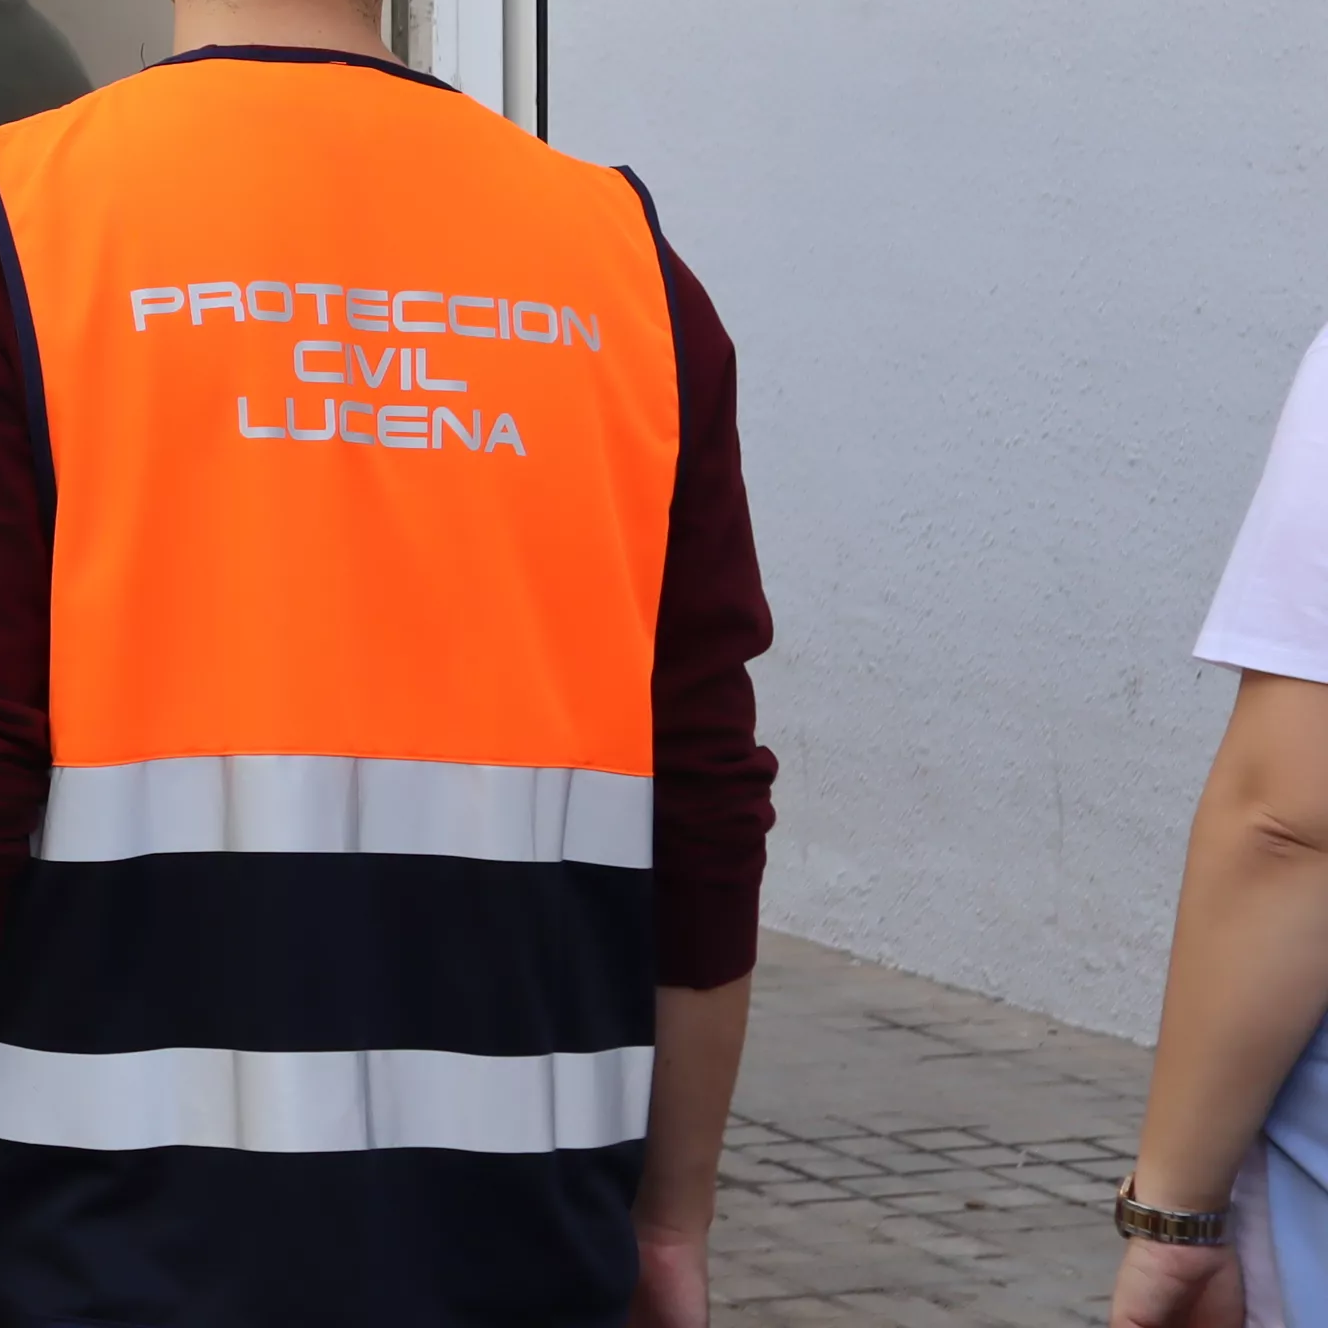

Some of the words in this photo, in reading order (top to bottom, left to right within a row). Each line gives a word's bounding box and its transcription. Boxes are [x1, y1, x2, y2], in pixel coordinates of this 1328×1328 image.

[130, 280, 601, 352] PROTECCION
[293, 340, 467, 392] CIVIL
[237, 396, 526, 457] LUCENA
